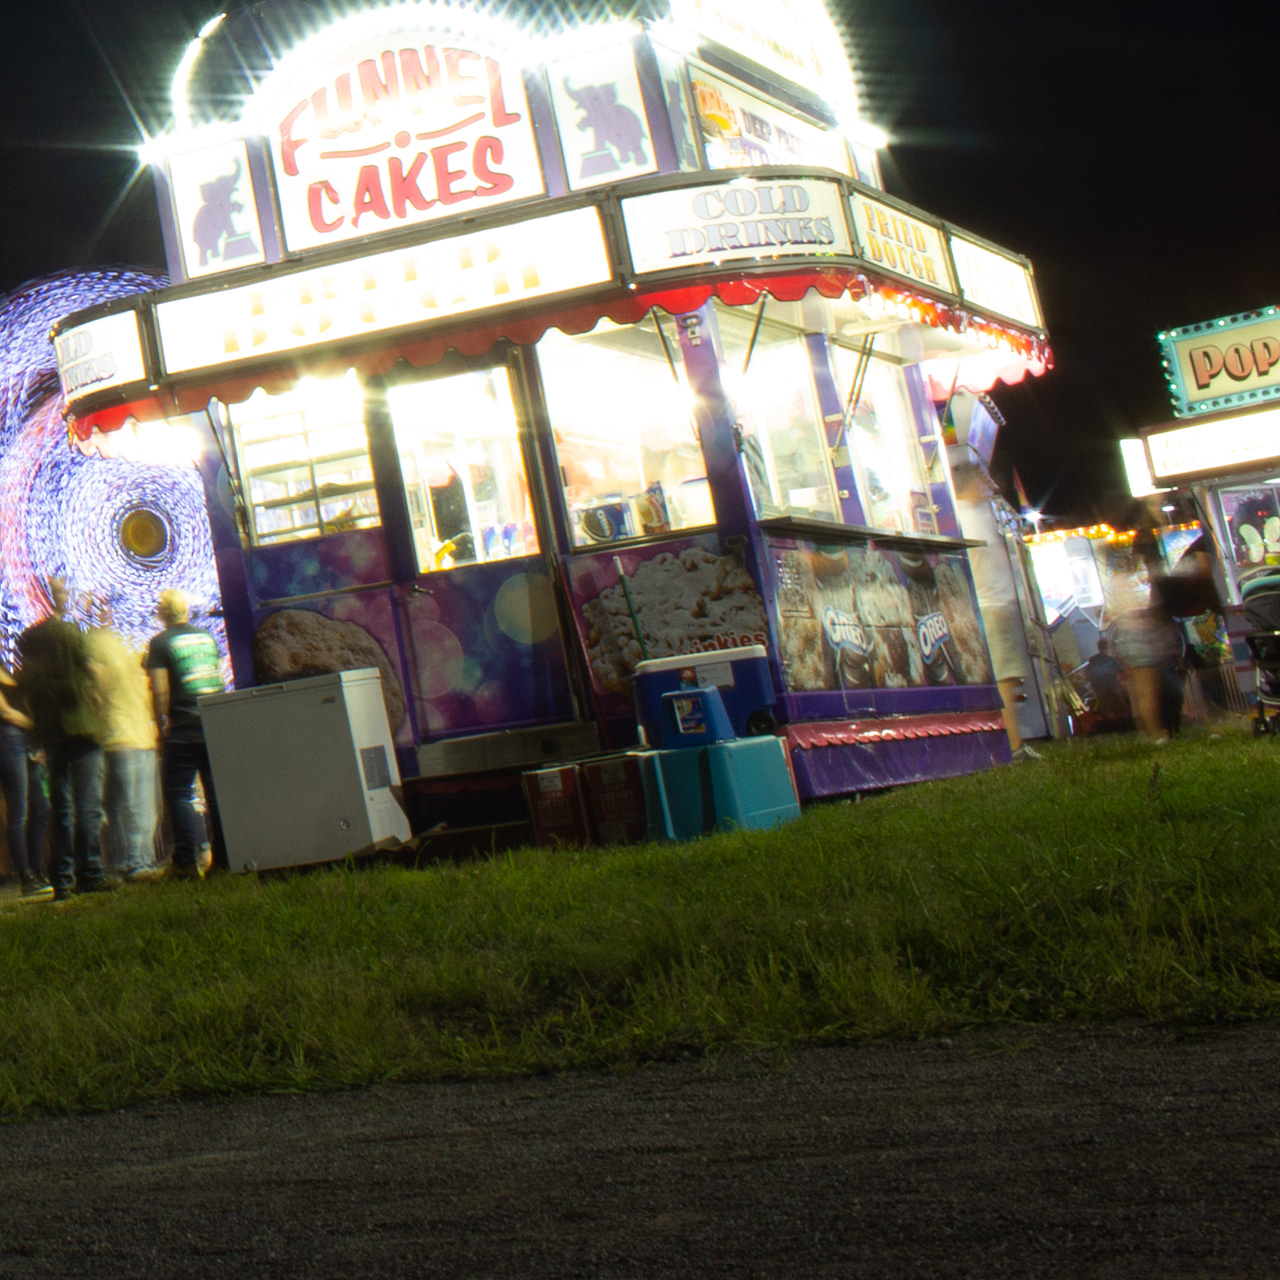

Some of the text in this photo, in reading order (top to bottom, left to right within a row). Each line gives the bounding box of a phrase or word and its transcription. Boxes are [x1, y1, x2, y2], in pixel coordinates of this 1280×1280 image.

[278, 44, 521, 177] FUNNEL
[307, 135, 514, 233] CAKES
[692, 185, 809, 220] COLD
[664, 216, 835, 259] DRINKS
[862, 202, 927, 253] FRIED
[866, 231, 939, 286] DOUGH
[1189, 336, 1280, 391] POP
[823, 608, 868, 651] OREO
[918, 614, 948, 659] OREO
